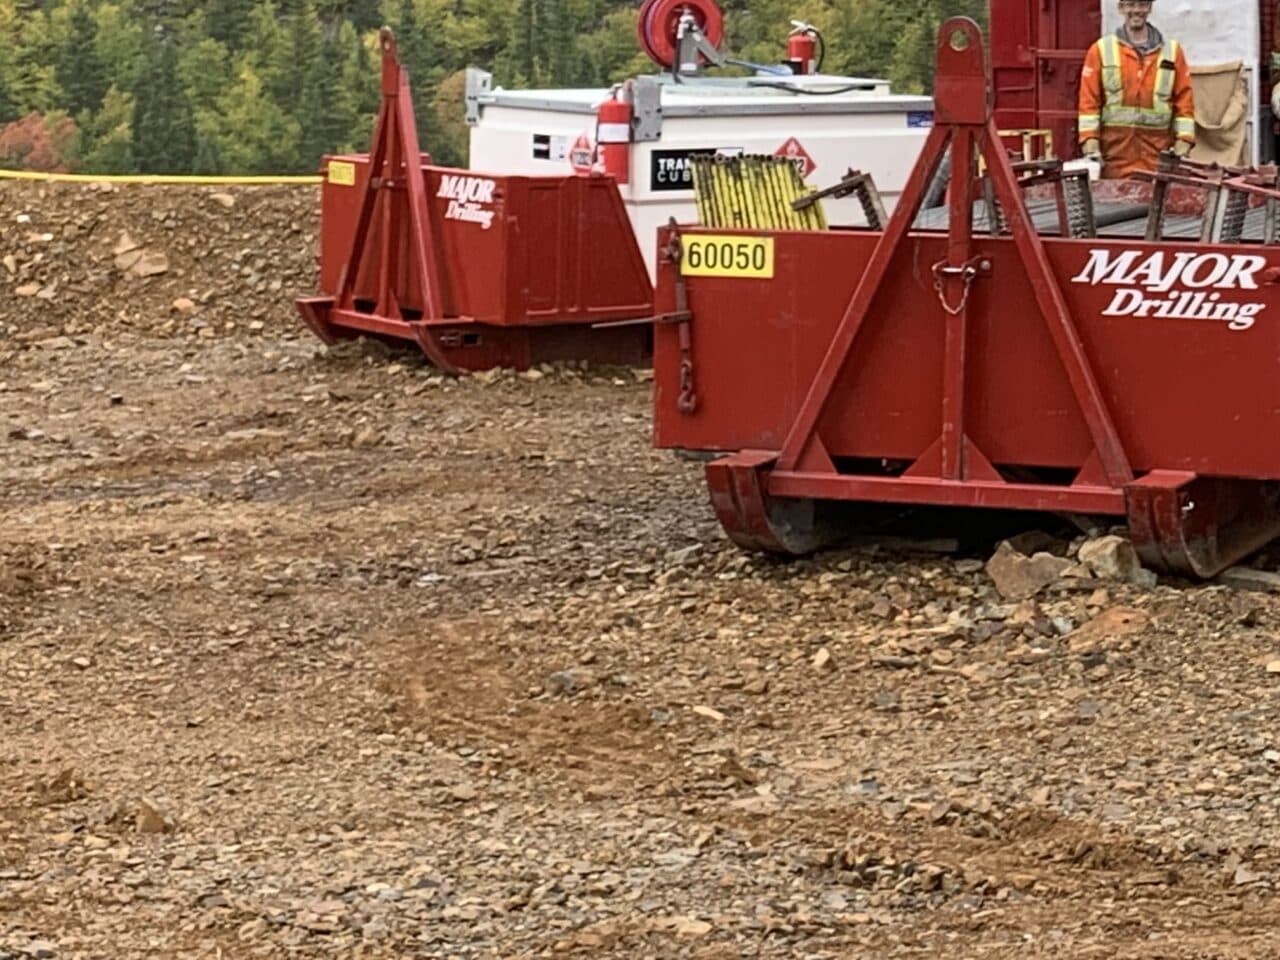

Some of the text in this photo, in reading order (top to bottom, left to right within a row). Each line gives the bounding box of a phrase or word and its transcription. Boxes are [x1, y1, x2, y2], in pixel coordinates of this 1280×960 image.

[436, 175, 496, 204] MAJOR
[657, 170, 691, 182] CUB
[444, 201, 495, 230] Drilling
[688, 242, 766, 270] 60050
[1071, 249, 1267, 292] MAJOR
[1101, 288, 1266, 330] Drilling
